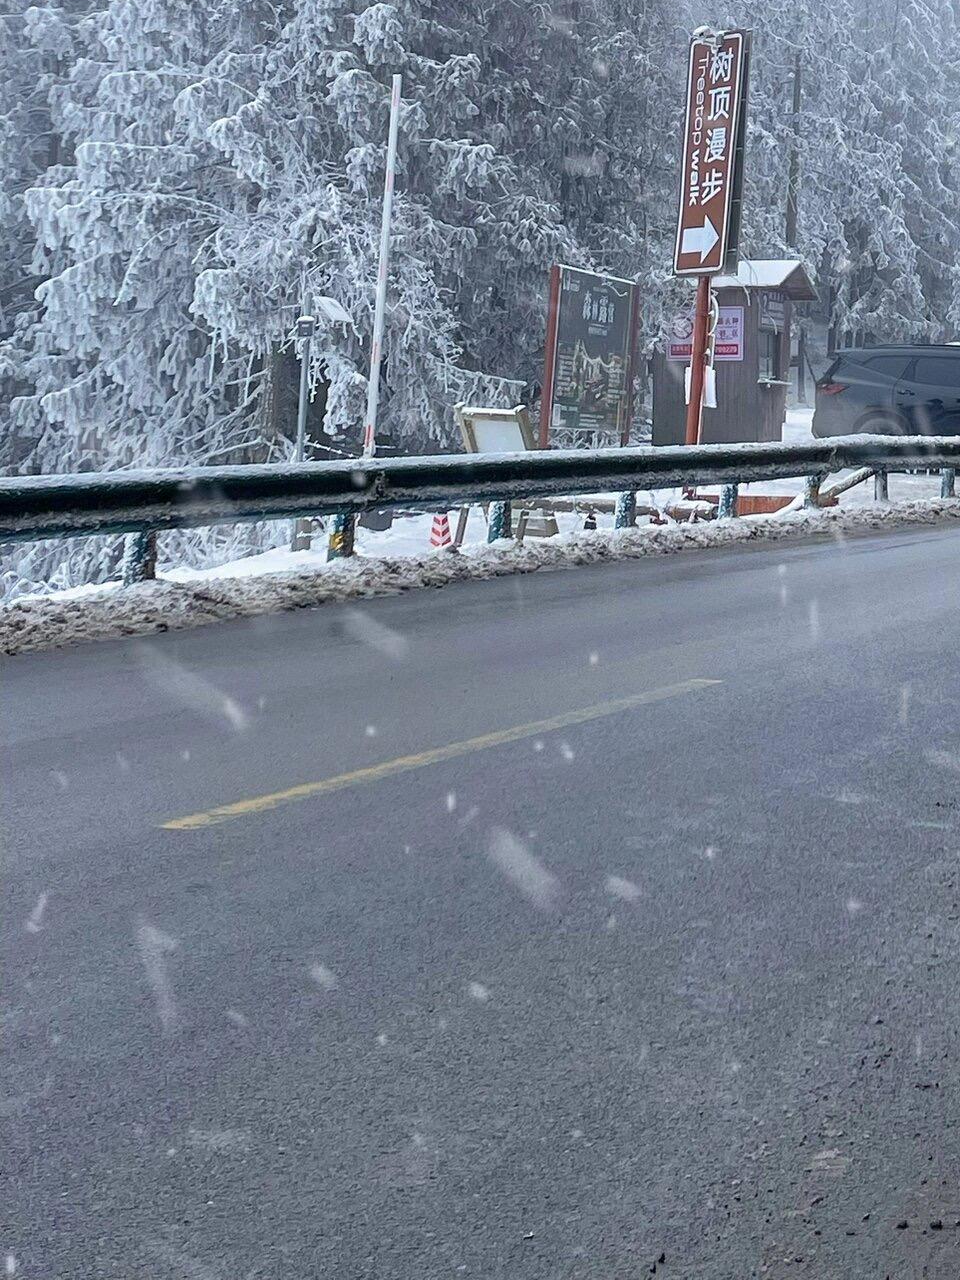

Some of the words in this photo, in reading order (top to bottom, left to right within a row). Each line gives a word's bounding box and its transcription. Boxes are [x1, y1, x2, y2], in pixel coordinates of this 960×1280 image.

[692, 51, 710, 146] Treetop
[701, 47, 734, 206] 树顶漫步
